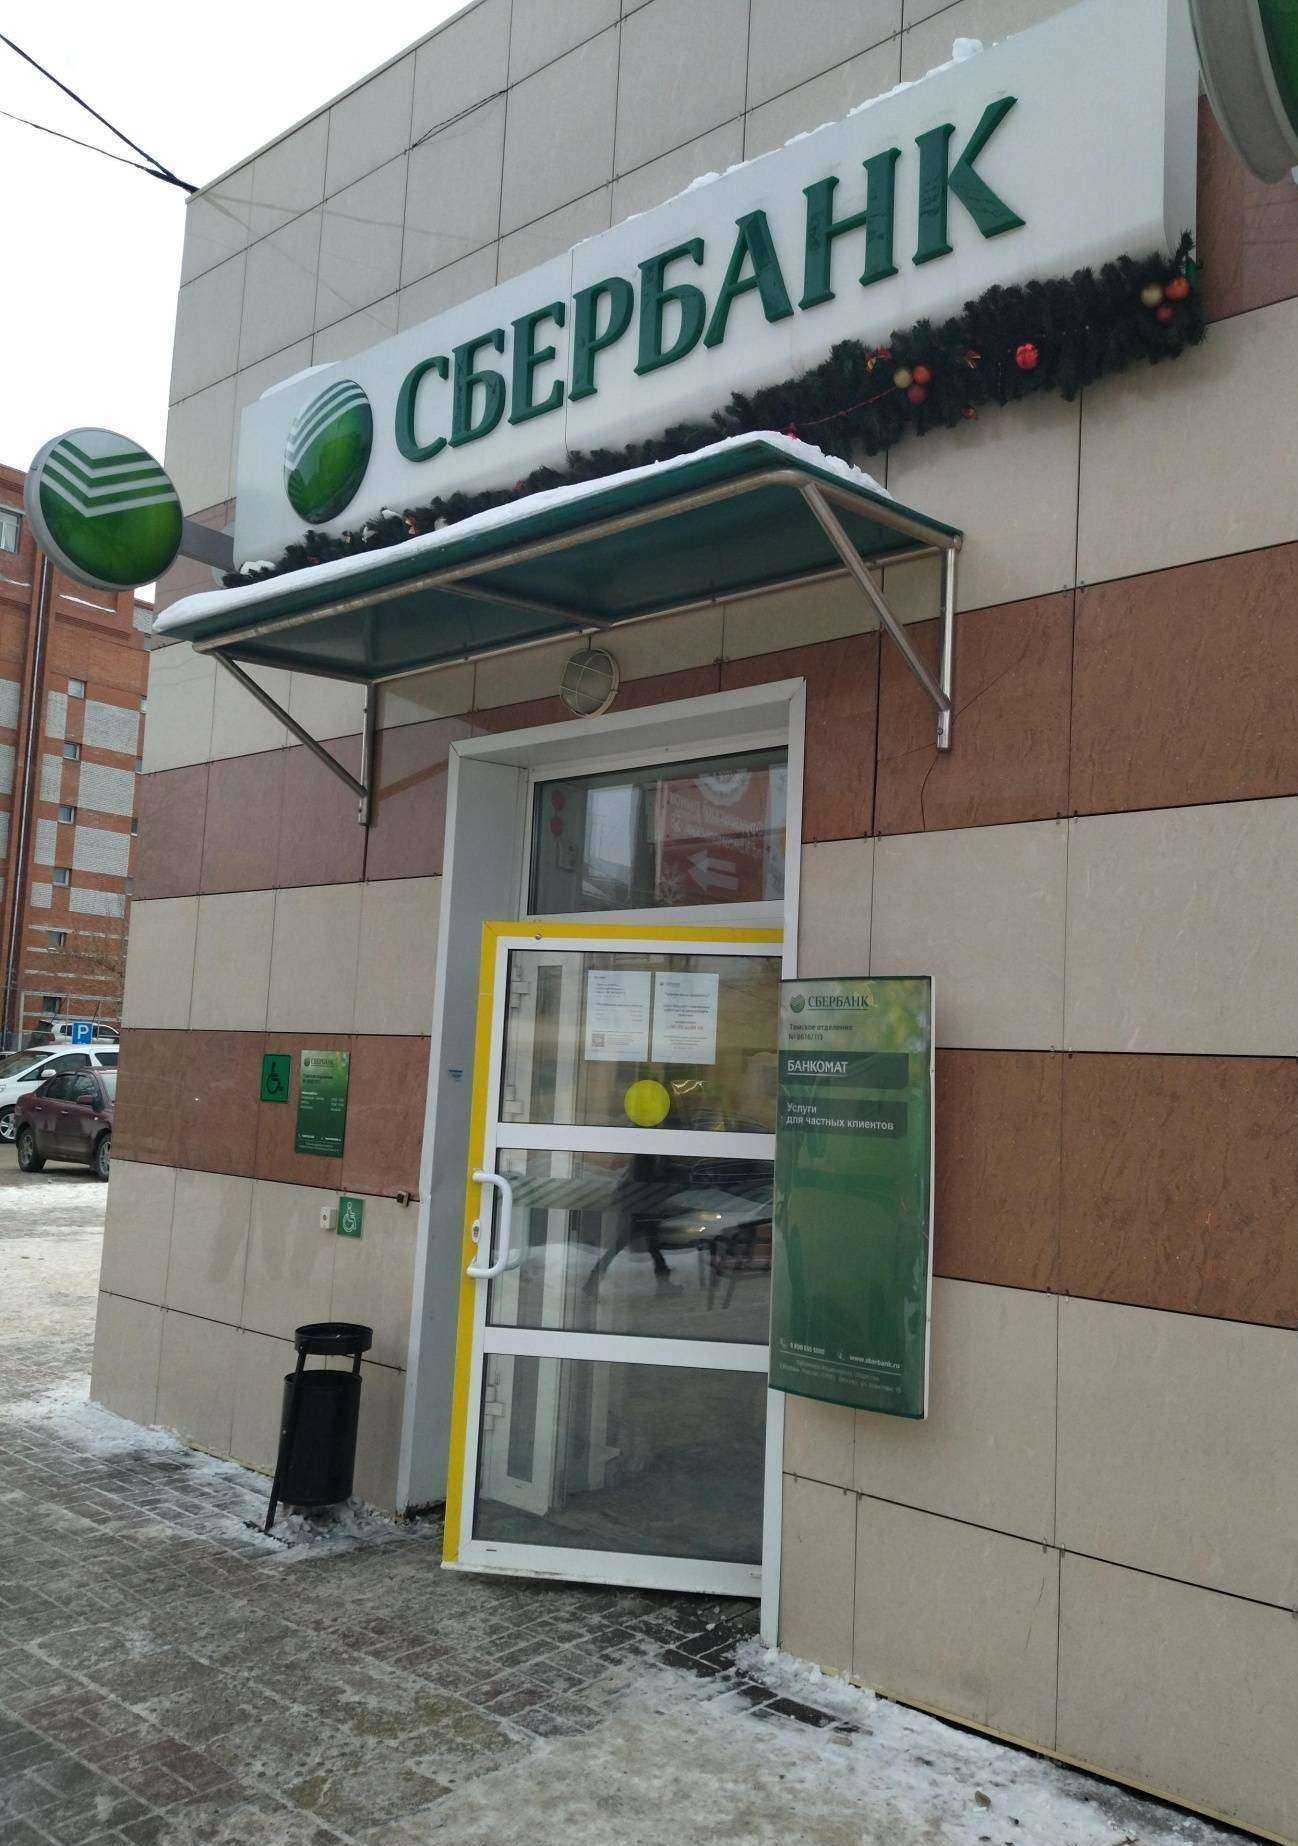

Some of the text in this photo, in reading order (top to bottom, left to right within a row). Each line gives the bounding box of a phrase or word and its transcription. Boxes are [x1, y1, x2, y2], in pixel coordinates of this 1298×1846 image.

[394, 95, 1026, 463] СБЕРБАНК
[807, 995, 869, 1008] СБЕРБАНК
[78, 1024, 89, 1040] P
[787, 1059, 849, 1074] БАНКОМАТ
[786, 1102, 817, 1115] Услуги
[785, 1115, 894, 1131] для частных клиентов
